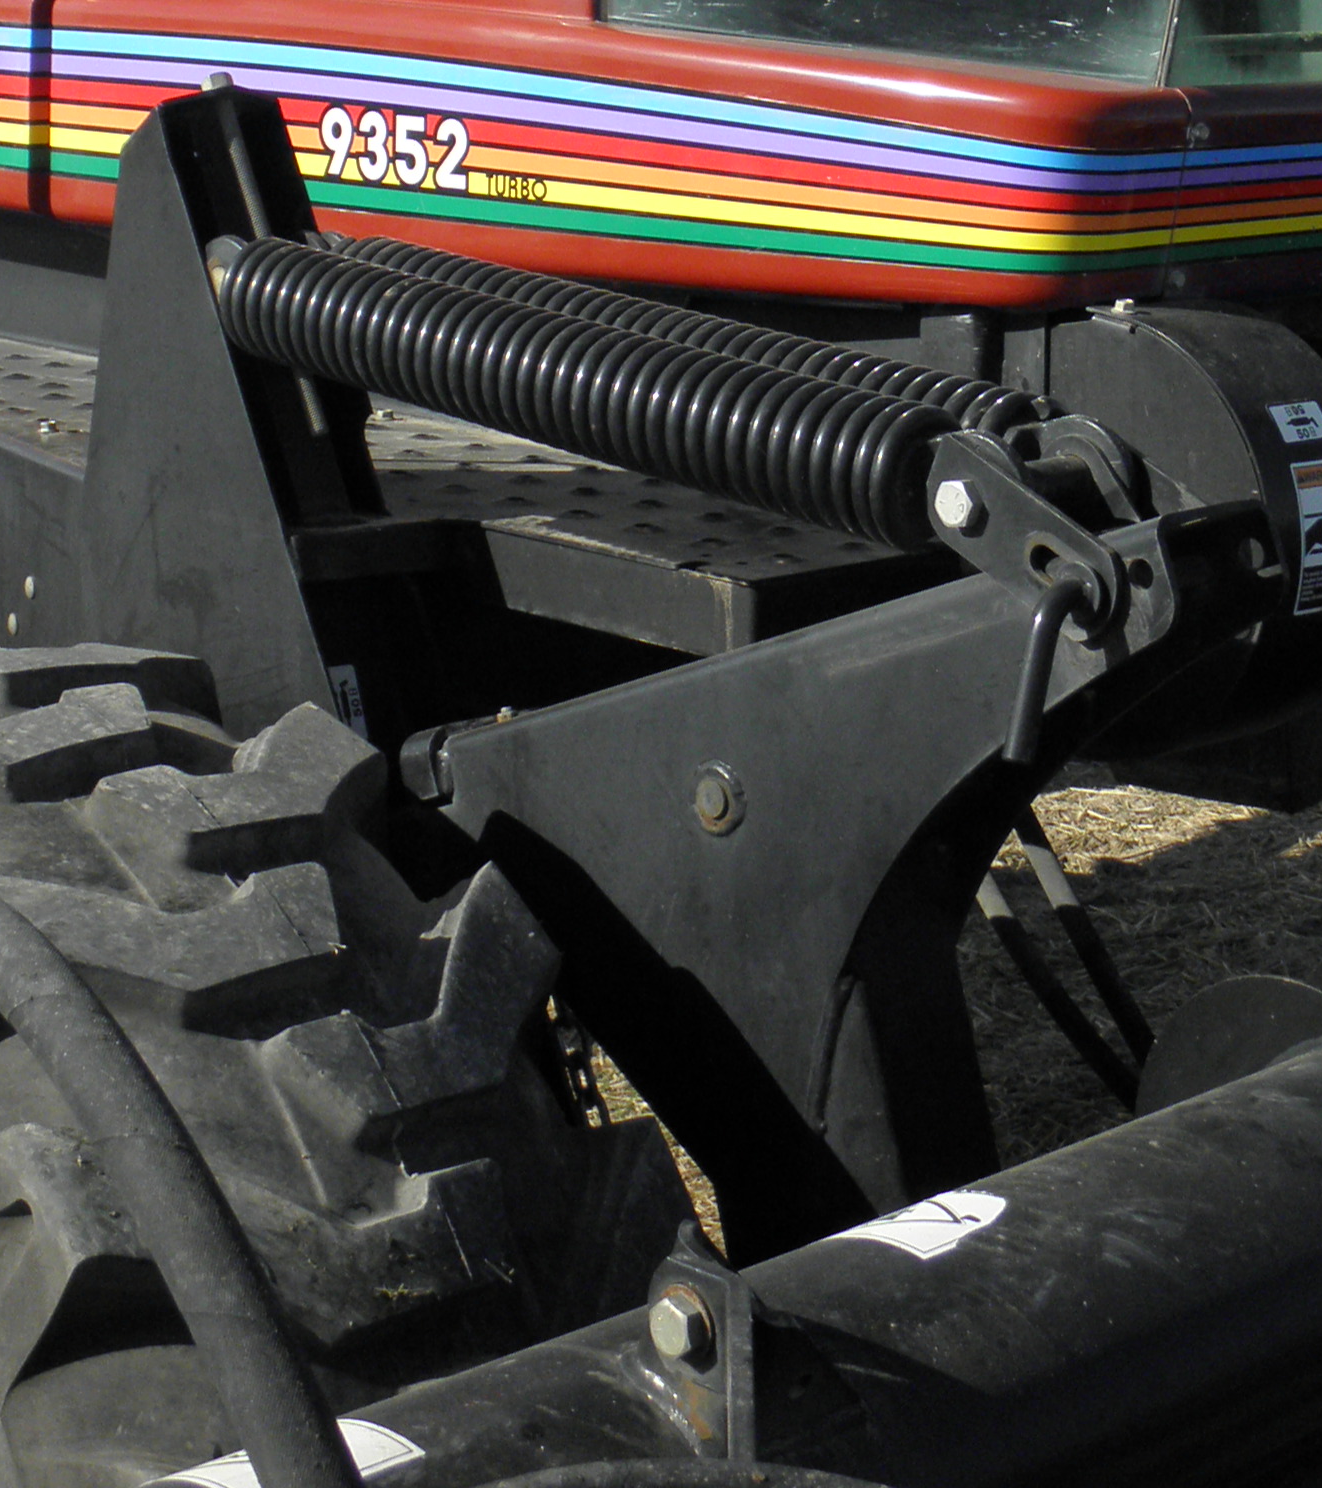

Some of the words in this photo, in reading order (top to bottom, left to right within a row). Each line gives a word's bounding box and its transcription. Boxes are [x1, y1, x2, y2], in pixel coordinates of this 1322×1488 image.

[319, 104, 469, 191] 9352
[485, 173, 547, 201] TURBO
[1295, 427, 1310, 440] 50
